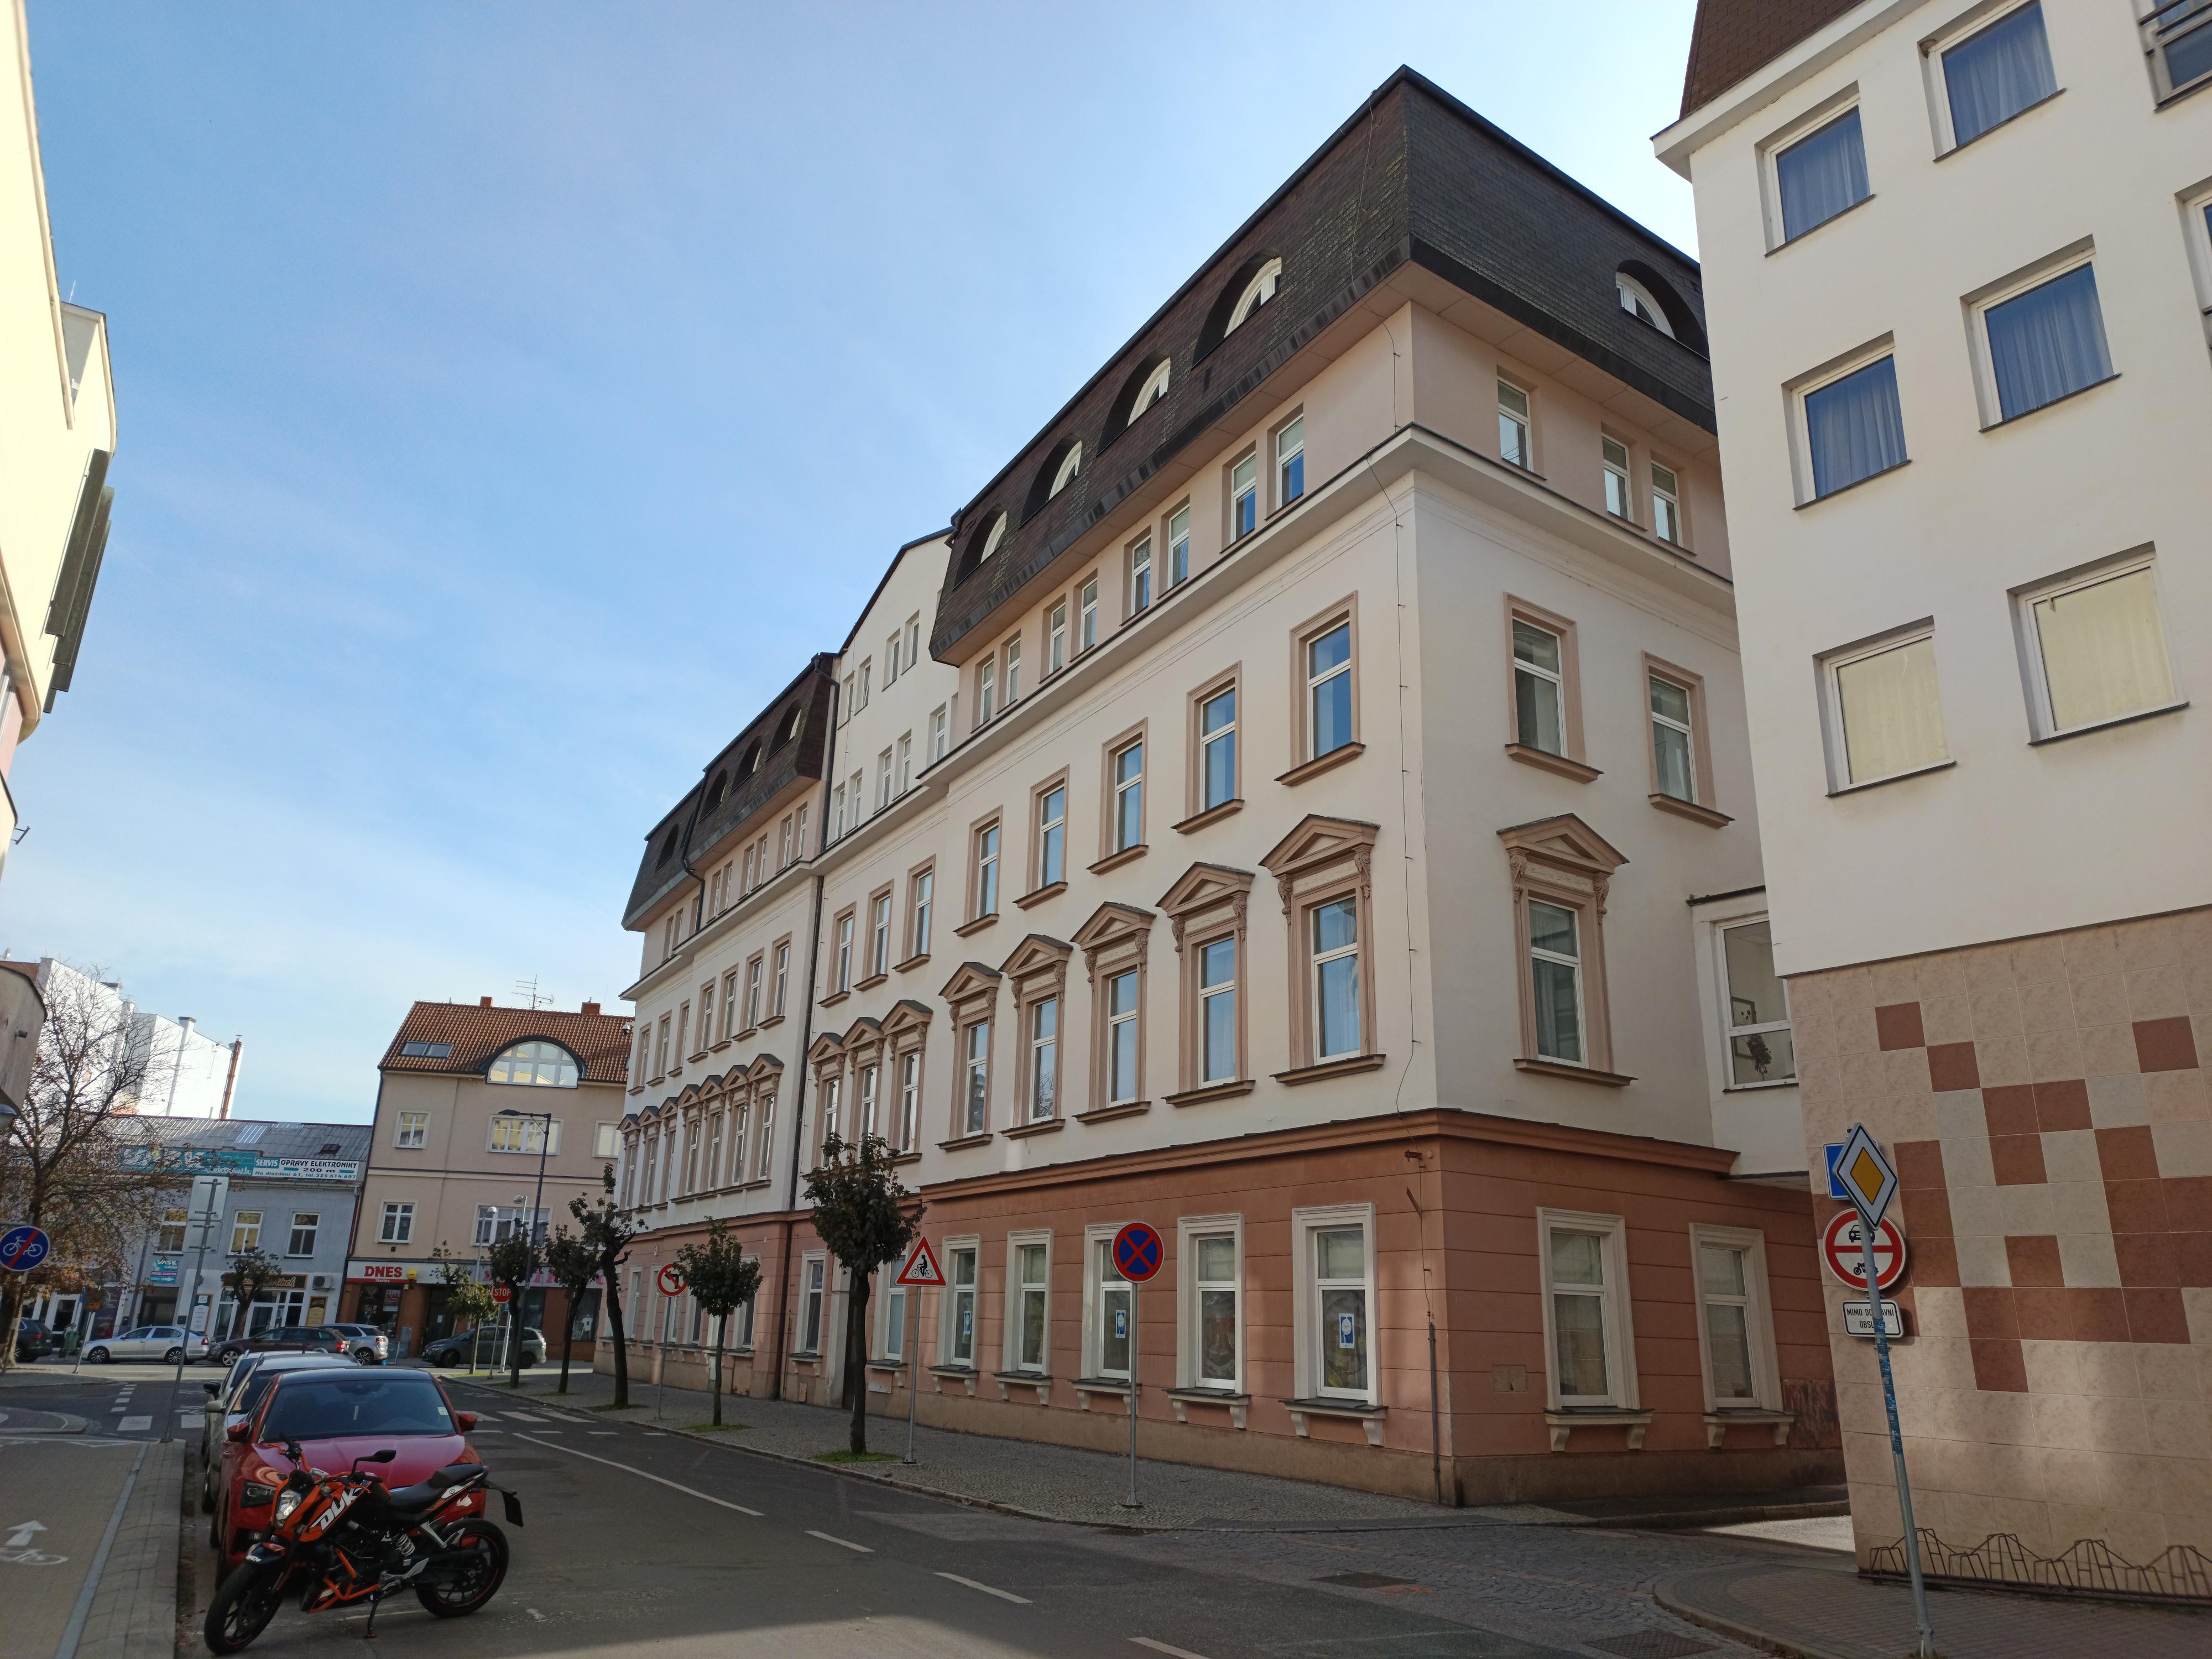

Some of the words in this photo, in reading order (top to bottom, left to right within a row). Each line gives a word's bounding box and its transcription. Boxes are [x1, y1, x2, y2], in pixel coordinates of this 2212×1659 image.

[364, 1266, 403, 1278] DNES
[494, 1288, 512, 1296] STOP
[1865, 1307, 1894, 1316] DOAVNÍ
